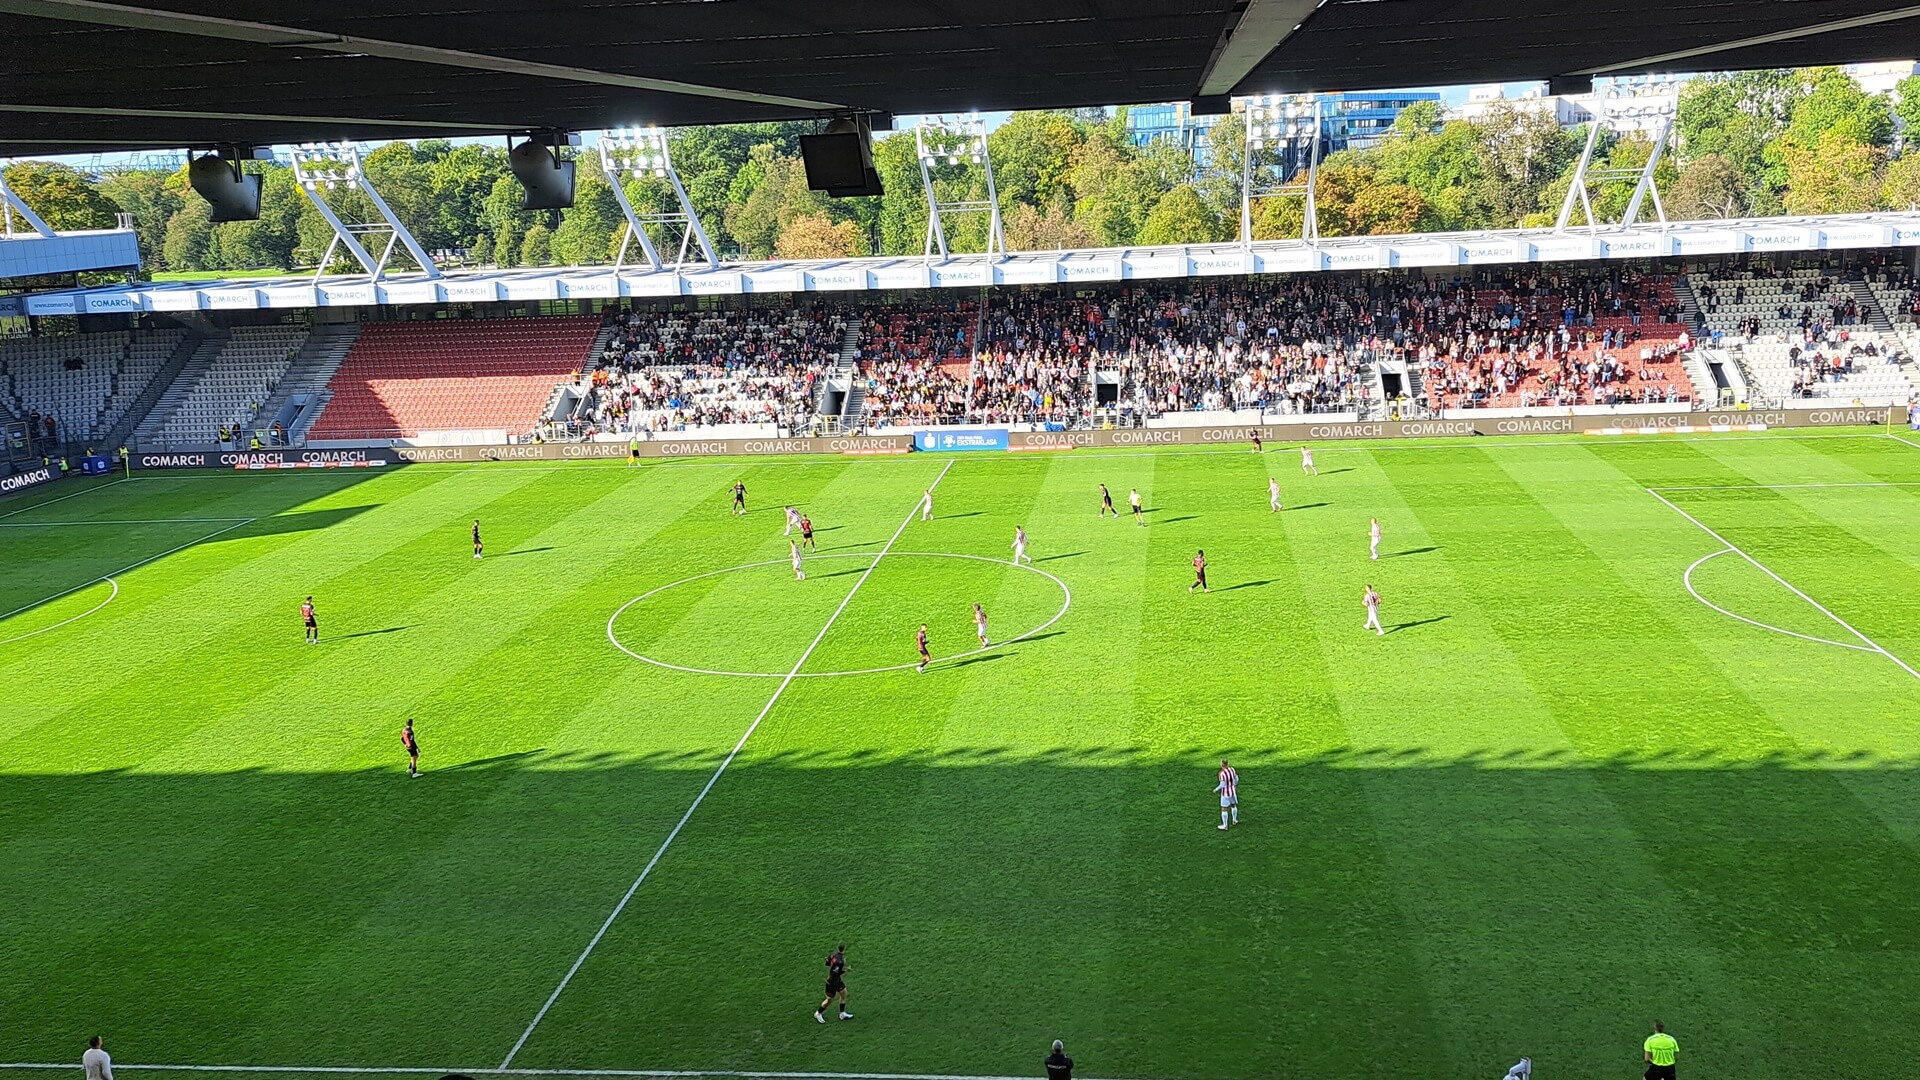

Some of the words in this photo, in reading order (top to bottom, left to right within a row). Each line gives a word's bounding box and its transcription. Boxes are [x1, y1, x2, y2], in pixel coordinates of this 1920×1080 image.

[1750, 236, 1800, 244] COMARCH
[1464, 248, 1512, 257] COMARCH
[1606, 242, 1655, 251] COMARCH
[1194, 260, 1239, 269] COMARCH
[1327, 254, 1373, 263] COMARCH
[1064, 266, 1108, 275] COMARCH
[324, 292, 366, 300] COMARCH
[91, 299, 131, 307] COMARCH
[1612, 416, 1688, 428] COMARCH
[1708, 414, 1785, 426] COMARCH
[1809, 411, 1887, 423] COMARCH
[1310, 425, 1382, 437] COMARCH
[1402, 422, 1474, 435] COMARCH
[1498, 420, 1572, 432] COMARCH
[1026, 434, 1094, 445] COMARCH
[1112, 431, 1180, 442] COMARCH
[1202, 428, 1272, 440] COMARCH
[562, 444, 627, 456] COMARCH
[662, 442, 726, 454] COMARCH
[744, 441, 810, 452] COMARCH
[830, 438, 896, 450] COMARCH
[220, 453, 283, 465] COMARCH
[302, 451, 366, 462] COMARCH
[398, 448, 462, 460] COMARCH
[478, 447, 542, 459] COMARCH
[142, 455, 204, 466] COMARCH
[1, 469, 50, 491] COMARCH
